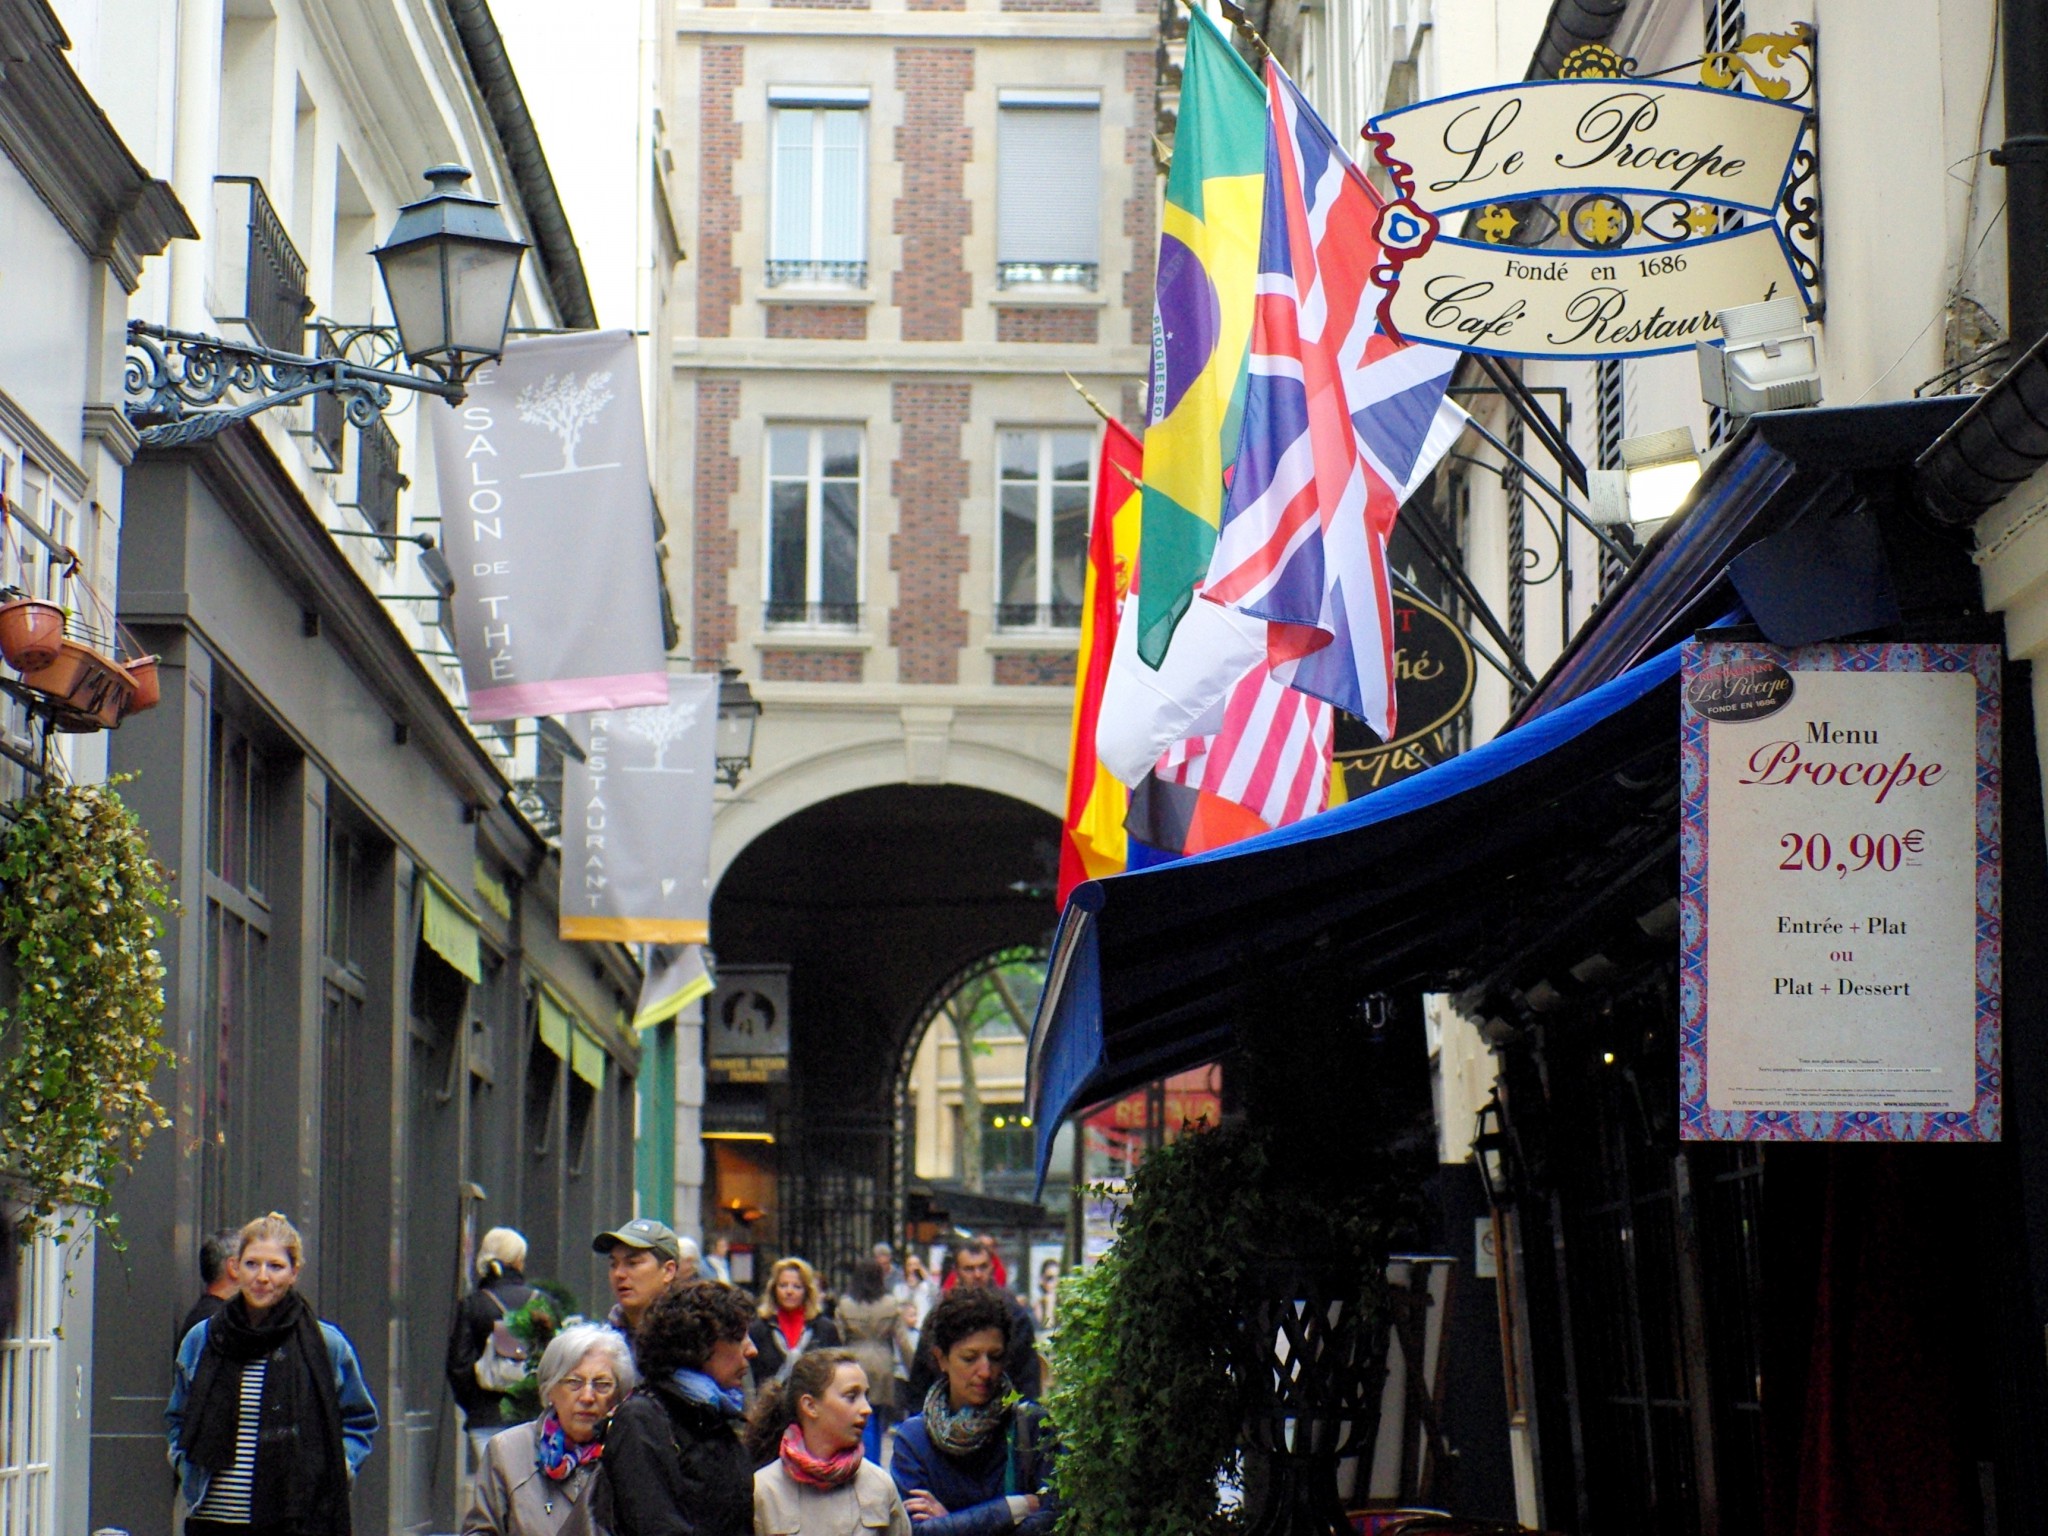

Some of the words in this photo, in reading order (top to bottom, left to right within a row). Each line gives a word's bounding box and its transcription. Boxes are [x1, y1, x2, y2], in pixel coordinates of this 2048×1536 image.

[1429, 98, 1525, 192] Le
[1555, 93, 1746, 190] Procope
[1505, 259, 1569, 281] Fondé
[1591, 265, 1616, 281] en
[1639, 255, 1687, 278] 1686
[1424, 275, 1526, 345] Café
[1547, 281, 1777, 345] Restaurt
[1153, 315, 1165, 417] PROGRESSO
[464, 407, 501, 542] SALON
[472, 561, 510, 577] DE
[479, 595, 514, 680] THÉ
[1689, 682, 1721, 703] Le
[1723, 677, 1789, 698] Procope
[1741, 702, 1753, 710] EN
[1805, 721, 1879, 745] Menu
[1739, 740, 1949, 804] Procope
[586, 718, 608, 908] RESTAURANT
[1779, 829, 1925, 879] 20,90€
[1776, 916, 1843, 935] Entrée
[1849, 922, 1860, 934] +
[1867, 917, 1907, 935] Plat
[1830, 951, 1854, 963] ou
[1774, 977, 1813, 996] Plat
[1820, 983, 1831, 994] +
[1838, 978, 1910, 996] Dessert
